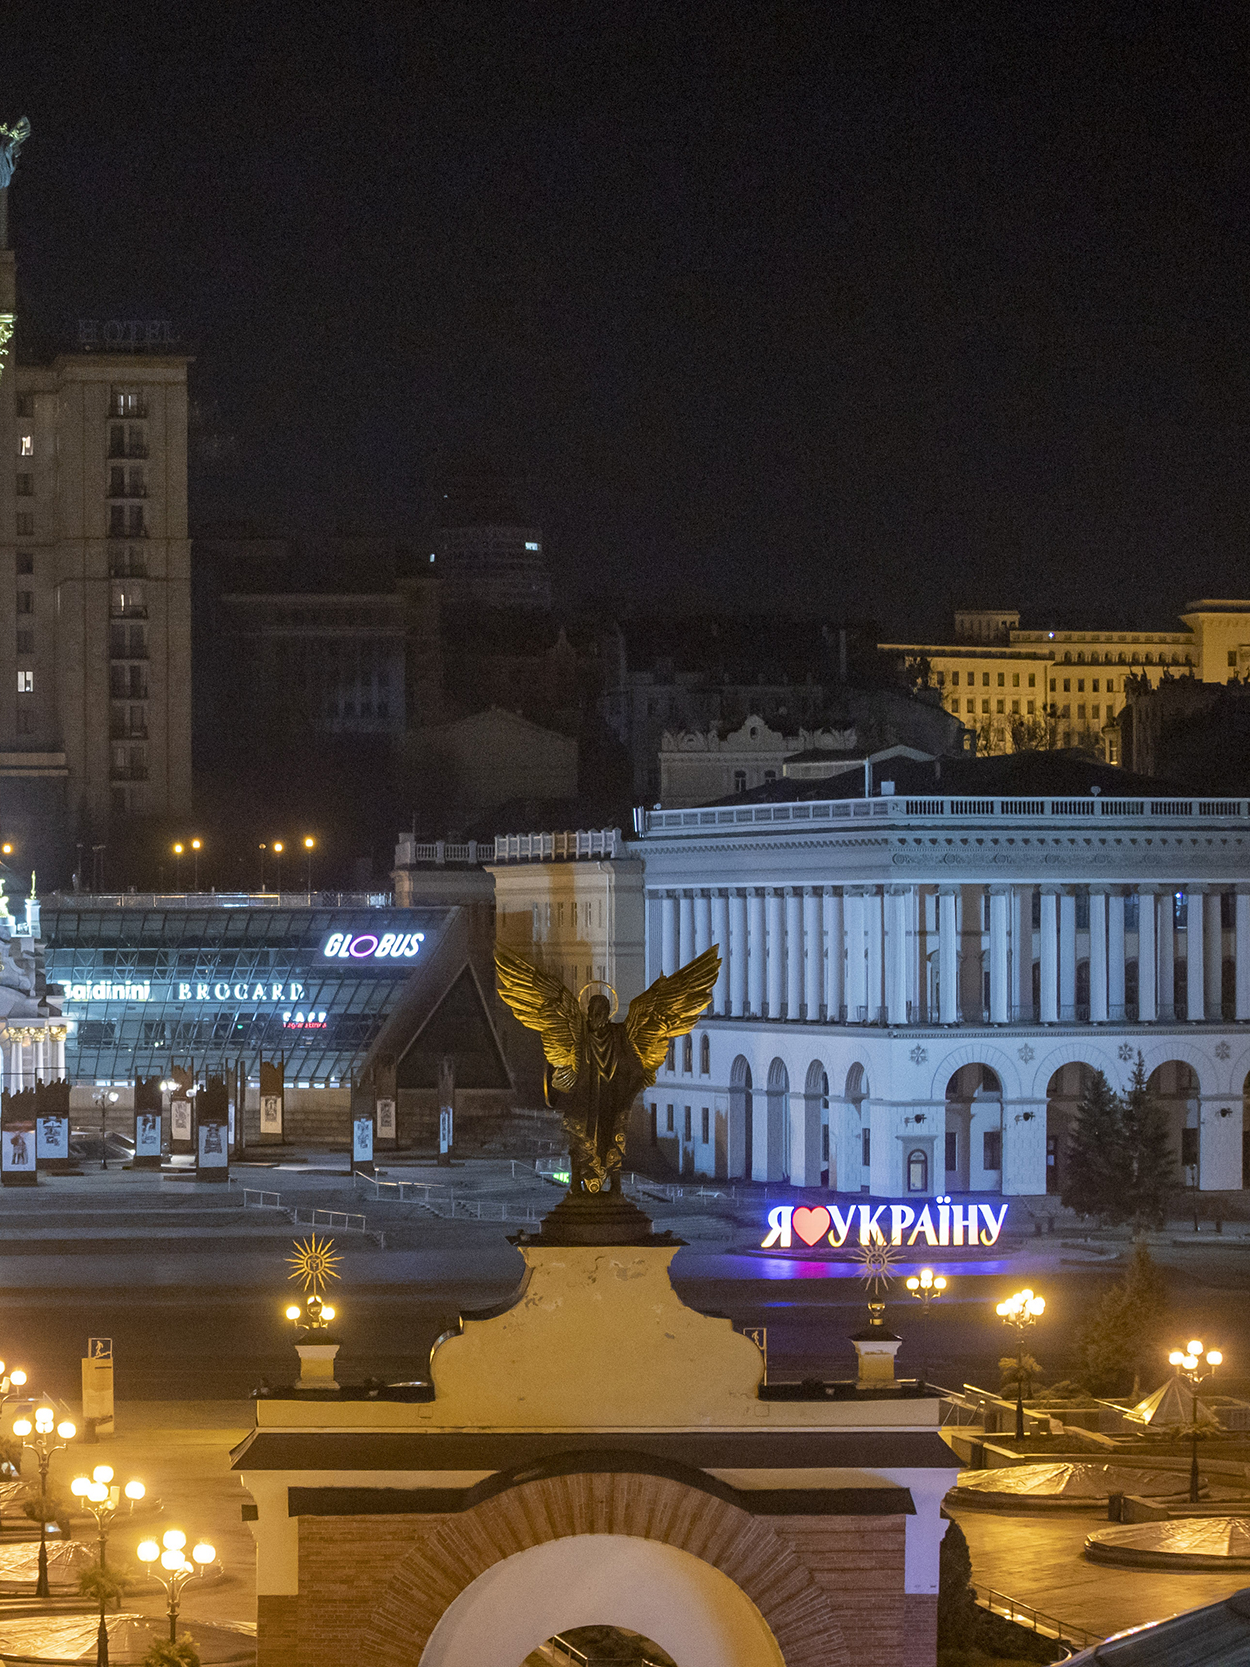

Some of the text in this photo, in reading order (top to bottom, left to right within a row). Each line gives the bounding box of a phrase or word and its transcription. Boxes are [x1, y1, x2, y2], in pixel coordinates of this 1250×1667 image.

[78, 319, 175, 342] HOTEL
[324, 932, 425, 960] GLOBUS
[178, 982, 305, 1000] BROCARD
[761, 1196, 1009, 1248] Я УКРАЇНУ
